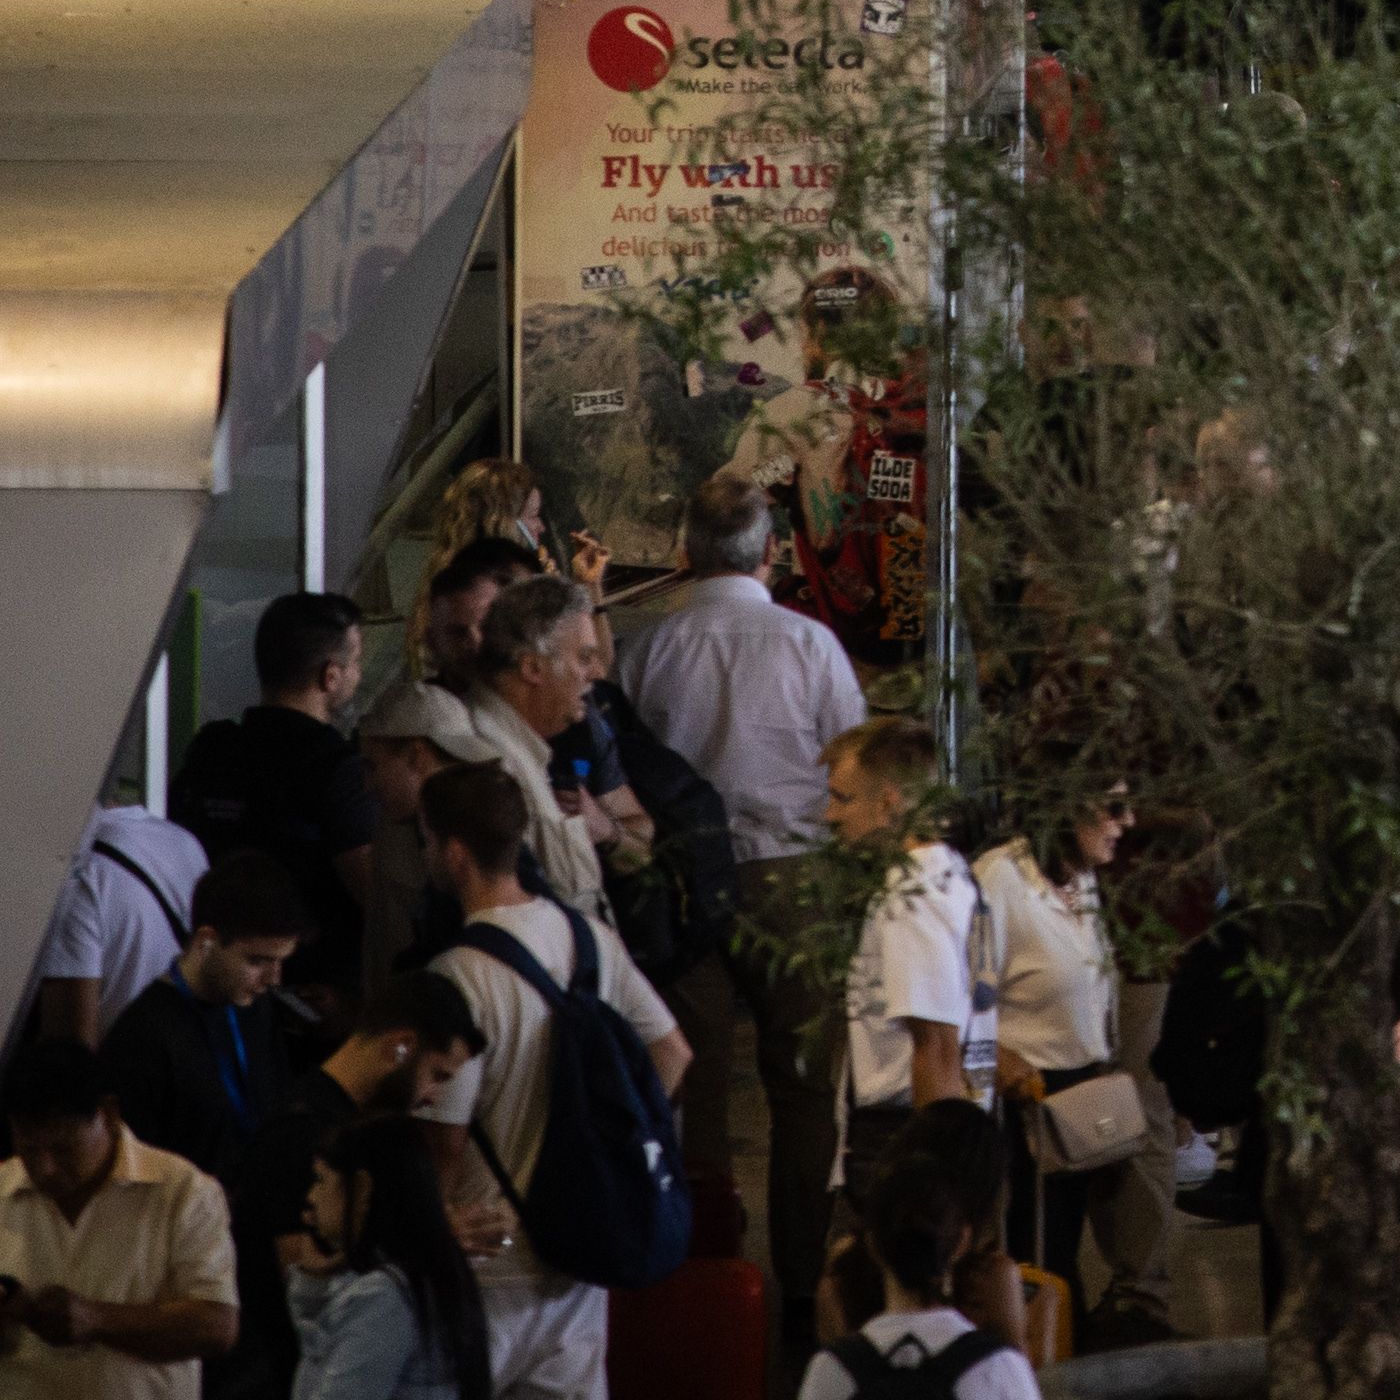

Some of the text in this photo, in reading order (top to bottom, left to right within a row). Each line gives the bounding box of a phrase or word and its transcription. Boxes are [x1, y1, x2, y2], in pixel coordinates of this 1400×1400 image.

[685, 30, 865, 69] selecta
[686, 78, 734, 94] Make
[741, 78, 771, 94] the
[606, 123, 655, 144] Your
[601, 155, 671, 197] Fly
[612, 203, 657, 223] And
[602, 236, 706, 257] delicious
[873, 458, 913, 479] ILDE
